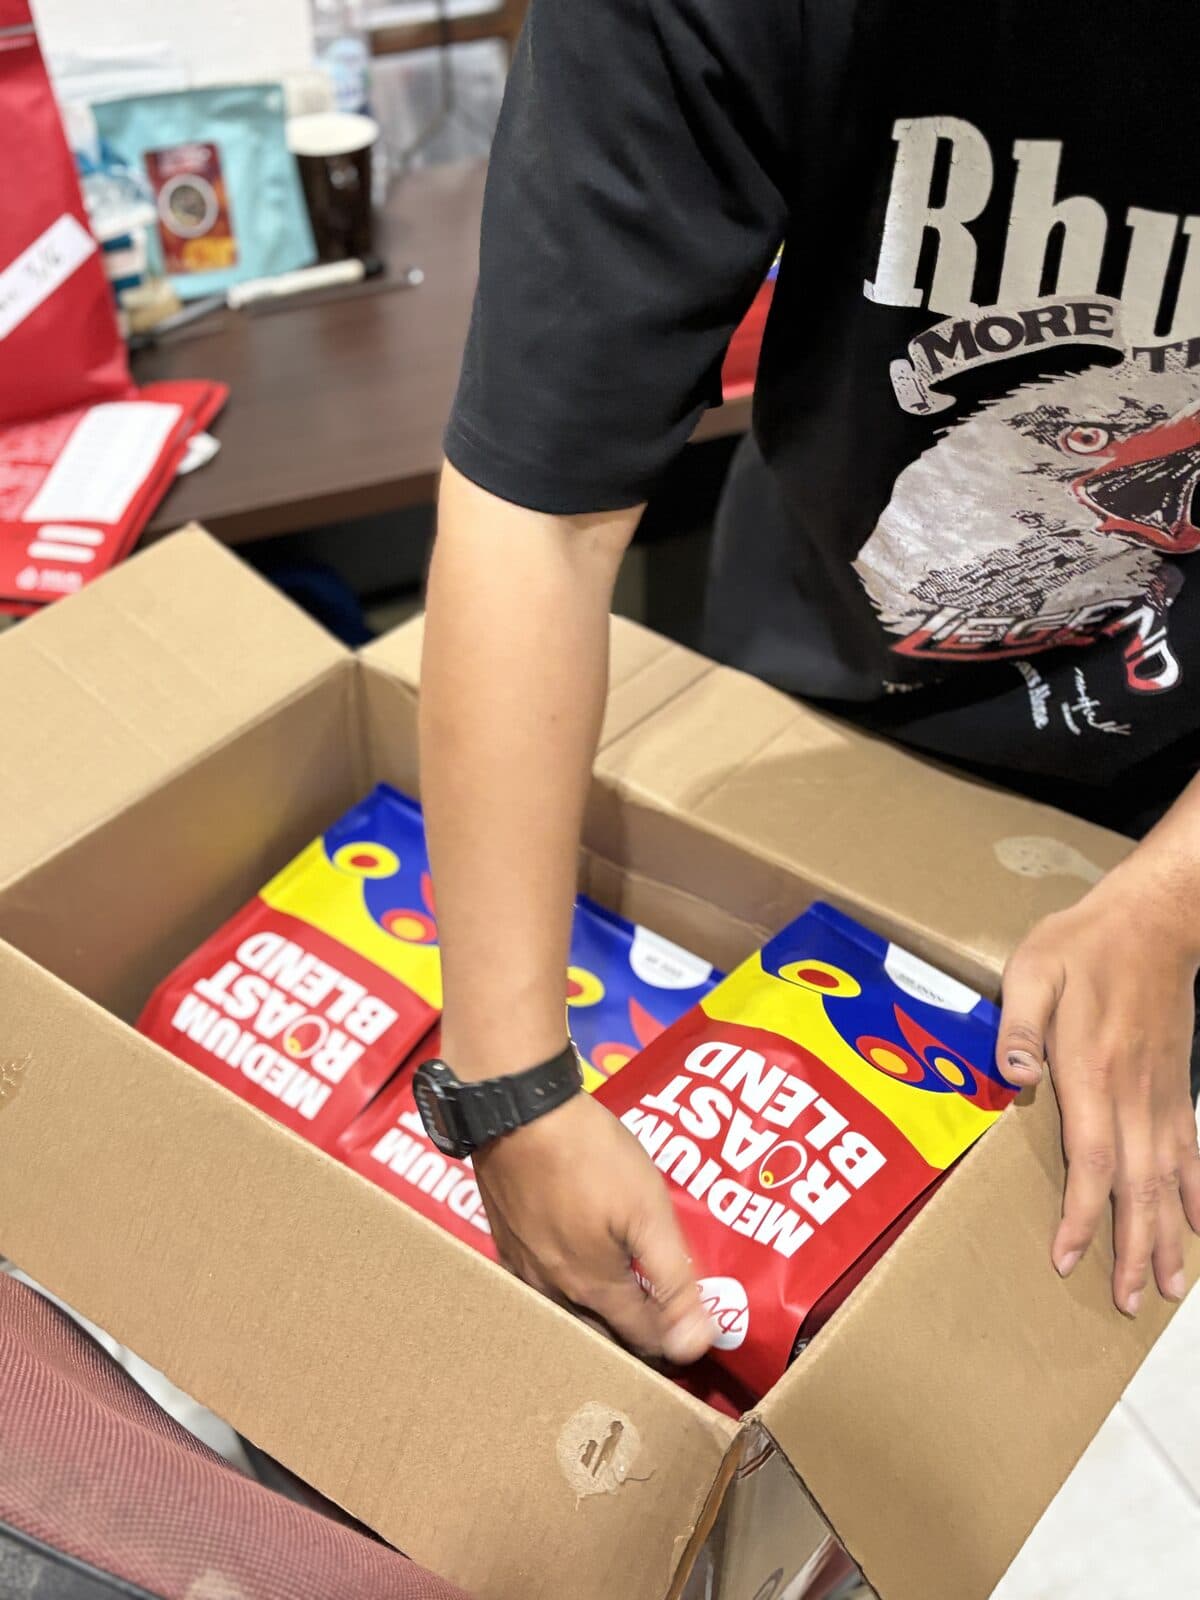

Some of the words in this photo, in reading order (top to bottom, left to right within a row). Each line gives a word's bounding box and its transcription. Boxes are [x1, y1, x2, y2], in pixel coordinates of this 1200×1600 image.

[913, 303, 1114, 373] MORE
[193, 961, 365, 1084] ROAST
[236, 931, 398, 1045] BLEND
[171, 993, 332, 1120] MEDIUM
[684, 1041, 887, 1190] BLEND
[619, 1108, 815, 1258] MEDIUM
[640, 1075, 851, 1226] ROAST
